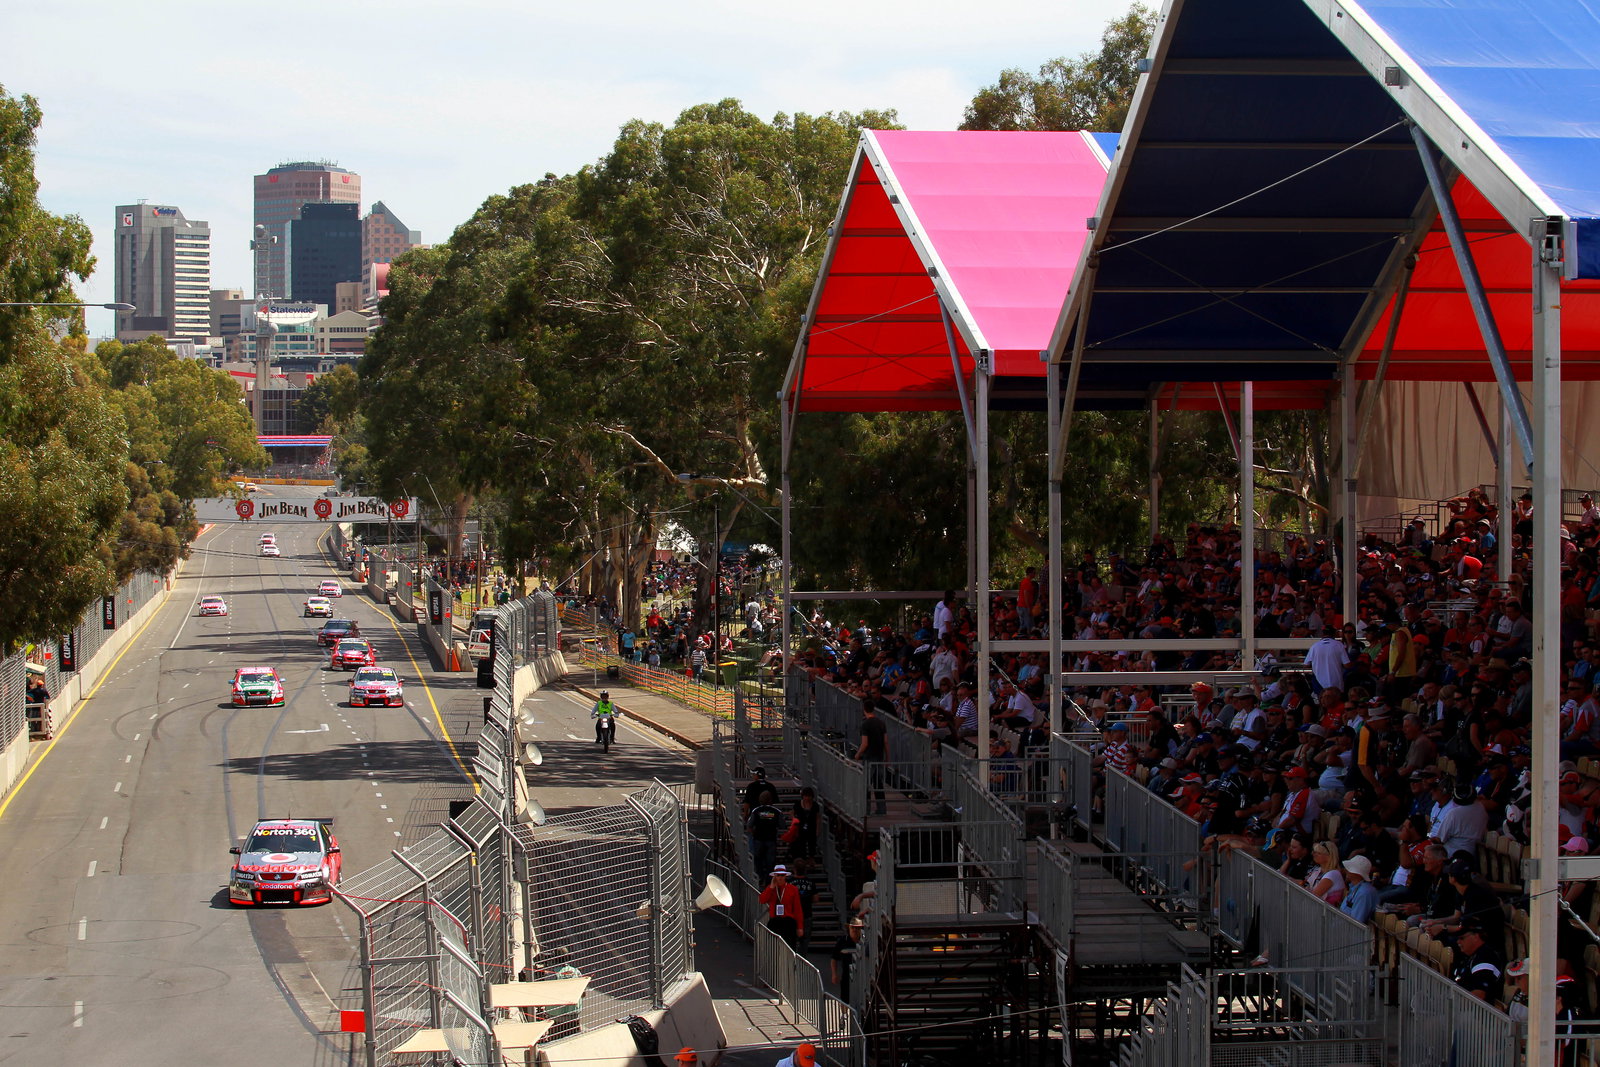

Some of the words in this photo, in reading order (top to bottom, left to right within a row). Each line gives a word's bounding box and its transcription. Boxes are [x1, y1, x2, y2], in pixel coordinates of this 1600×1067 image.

[270, 306, 314, 314] Statewide
[258, 502, 279, 518] JIM
[279, 501, 309, 518] BEAM
[336, 502, 356, 518] JIM
[357, 501, 387, 518] BEAM
[294, 828, 317, 836] 360
[240, 863, 319, 873] vodafone
